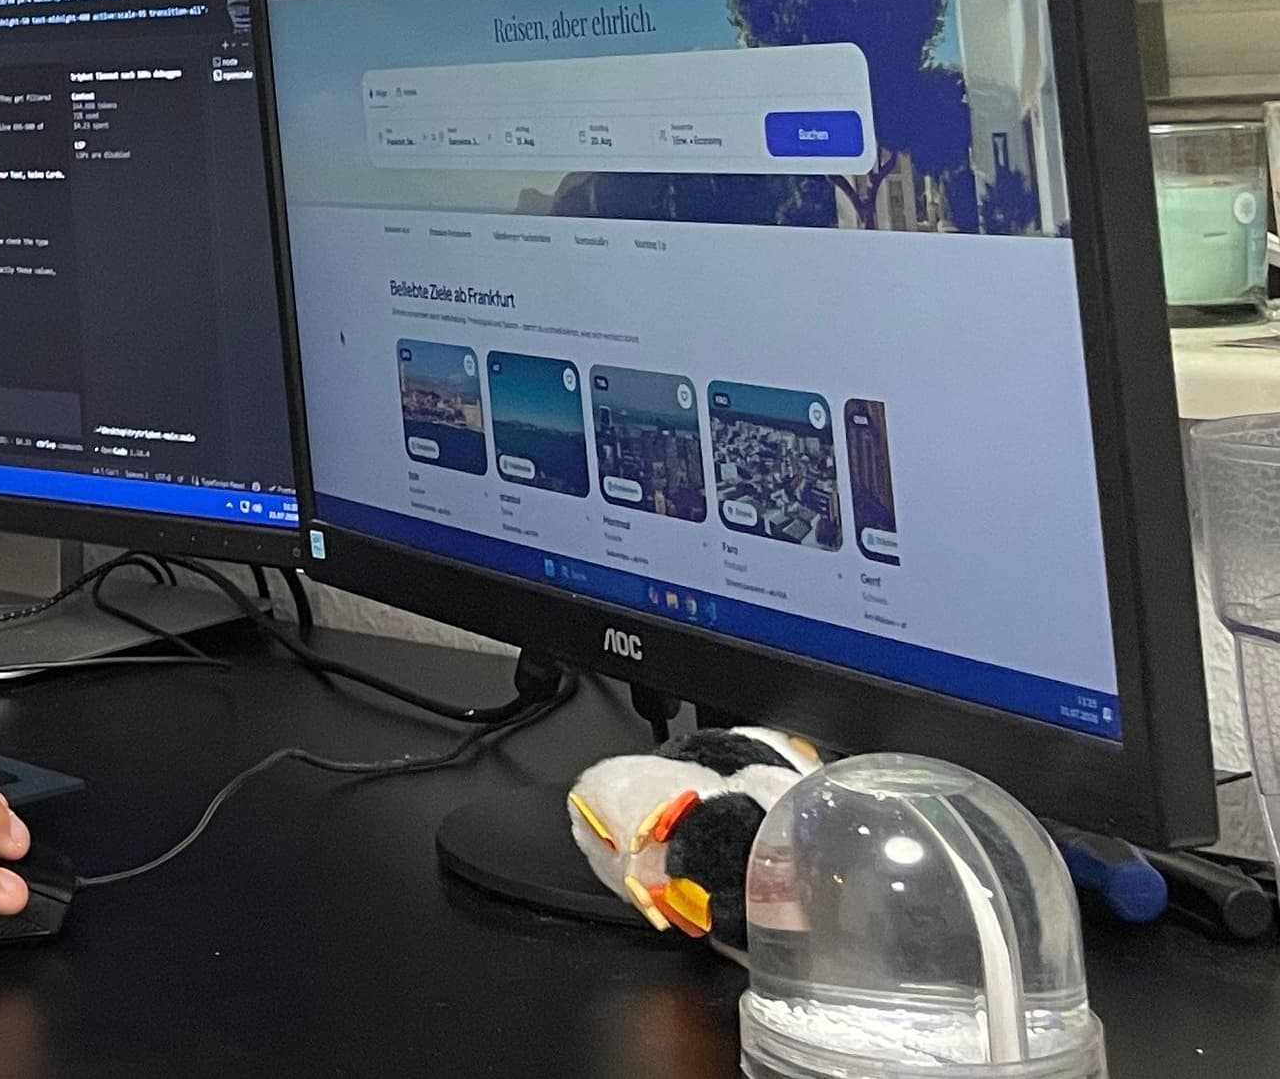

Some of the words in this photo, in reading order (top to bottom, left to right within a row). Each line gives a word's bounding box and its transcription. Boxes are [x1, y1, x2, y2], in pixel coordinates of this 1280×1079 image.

[494, 17, 550, 44] Reisen,
[552, 11, 589, 40] aber
[592, 3, 657, 38] ehrlich.
[798, 128, 829, 141] Suchen
[390, 280, 429, 299] Beliebte
[430, 284, 453, 302] Ziele
[454, 287, 467, 303] ab
[468, 288, 516, 309] Frankfurt
[603, 627, 643, 661] AOC
